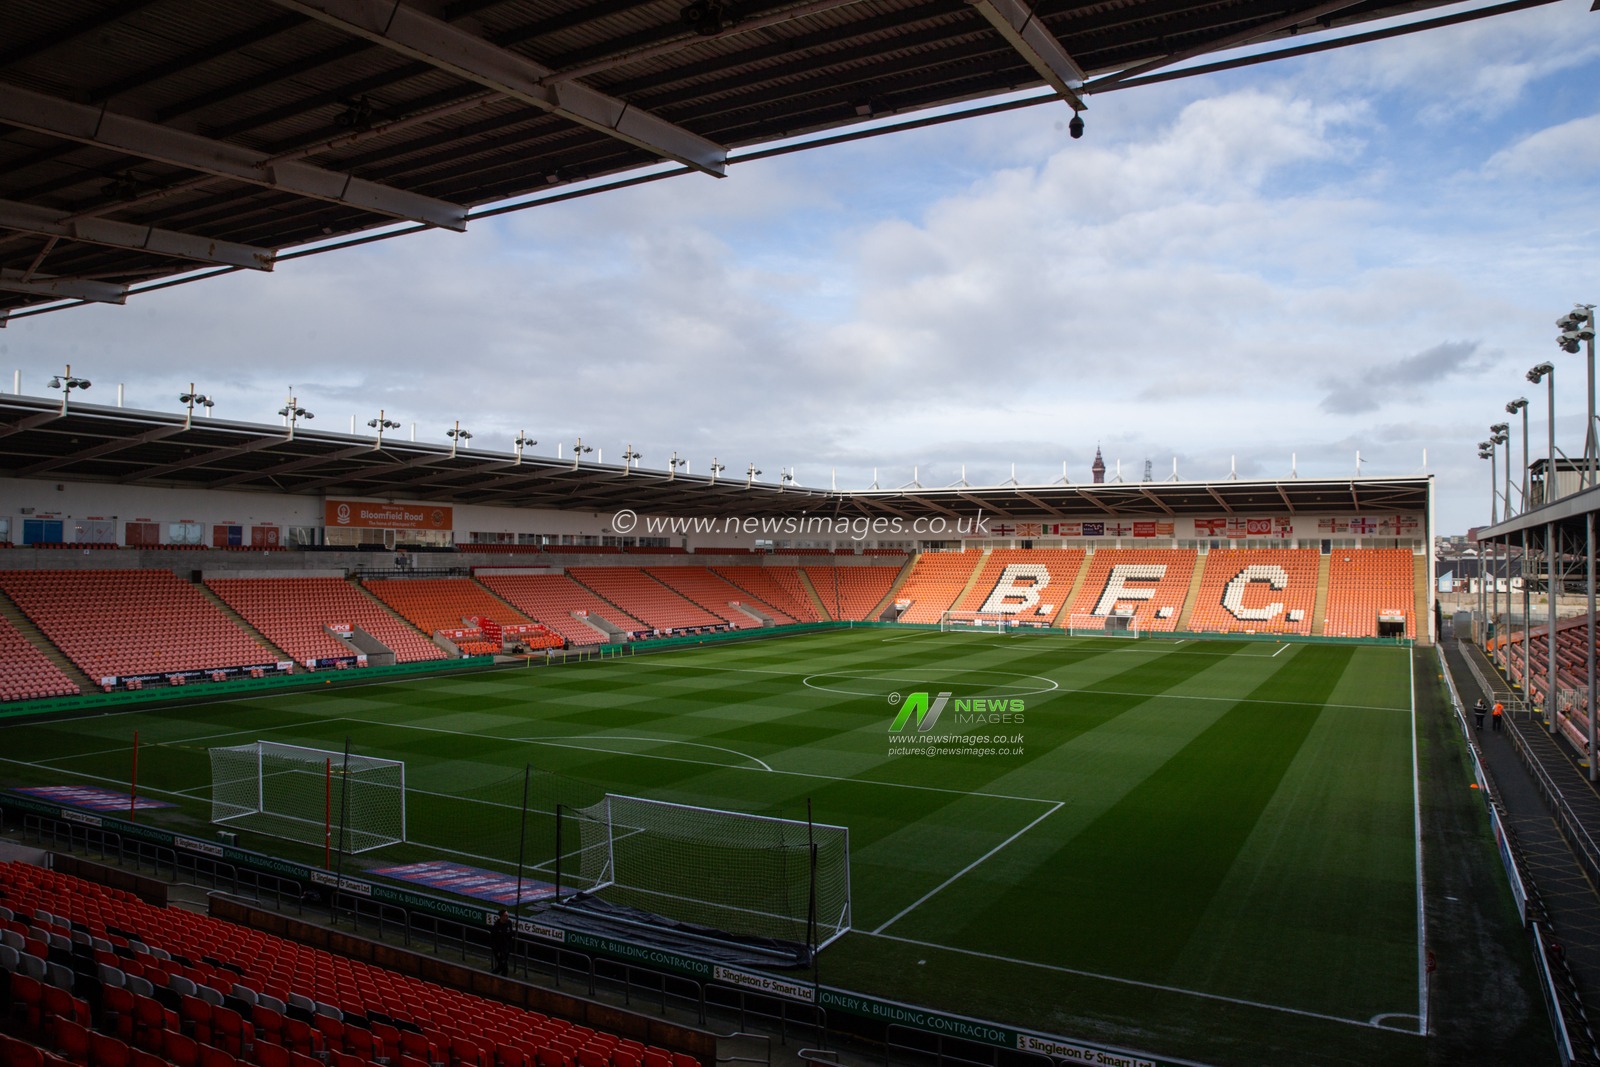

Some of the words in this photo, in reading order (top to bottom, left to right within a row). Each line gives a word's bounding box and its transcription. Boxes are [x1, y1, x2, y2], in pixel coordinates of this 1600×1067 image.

[360, 510, 402, 520] Bloomfield
[404, 512, 424, 521] Road
[224, 850, 243, 860] JOINERY
[249, 856, 274, 869] BUILDING
[274, 862, 309, 878] CONTRACTOR
[346, 881, 360, 891] Smart
[373, 888, 397, 900] JOINERY
[404, 895, 435, 910] BUILDING
[437, 903, 482, 920] CONTRACTOR
[525, 922, 531, 931] &
[532, 924, 550, 936] Smart
[552, 930, 562, 939] Ltd
[568, 932, 599, 948] JOINERY
[609, 942, 648, 960] BUILDING
[650, 953, 708, 974] CONTRACTOR
[722, 969, 761, 986] Singleton
[763, 980, 770, 988] &
[772, 982, 796, 995] Smart
[799, 988, 812, 999] Ltd
[819, 992, 858, 1010] JOINERY
[862, 1002, 870, 1012] &
[872, 1004, 924, 1025] BUILDING
[927, 1017, 1006, 1042] CONTRACTOR
[1029, 1038, 1081, 1059] Singleton
[1084, 1050, 1094, 1060] &
[1097, 1053, 1130, 1067] Smart
